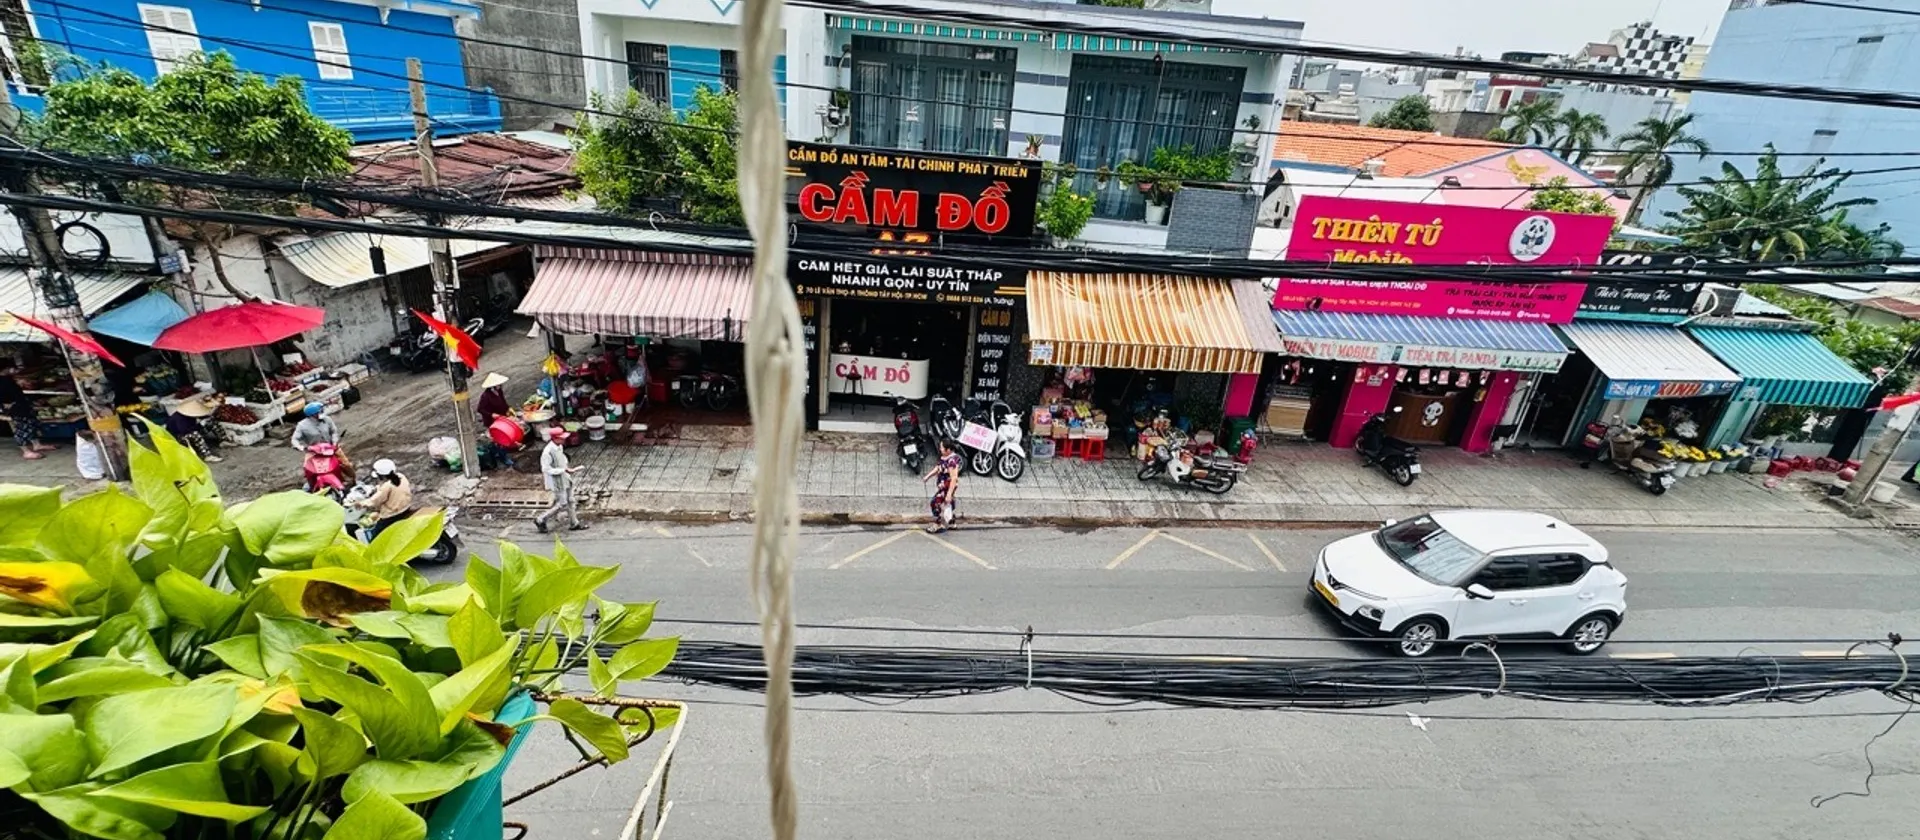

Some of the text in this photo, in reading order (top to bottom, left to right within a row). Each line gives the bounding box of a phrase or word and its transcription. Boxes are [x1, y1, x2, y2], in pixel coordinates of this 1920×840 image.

[841, 153, 858, 165] AN
[798, 171, 1012, 234] CẦM ĐỒ
[1312, 214, 1444, 246] THIÊN TÚ
[832, 274, 881, 287] NHANH
[883, 277, 915, 290] GỌN
[926, 280, 945, 290] UY
[948, 279, 970, 292] TÍN
[1621, 288, 1652, 303] Trang
[981, 349, 1004, 359] LAPTOP
[1458, 352, 1497, 366] PANDA
[884, 362, 911, 383] ĐỒ
